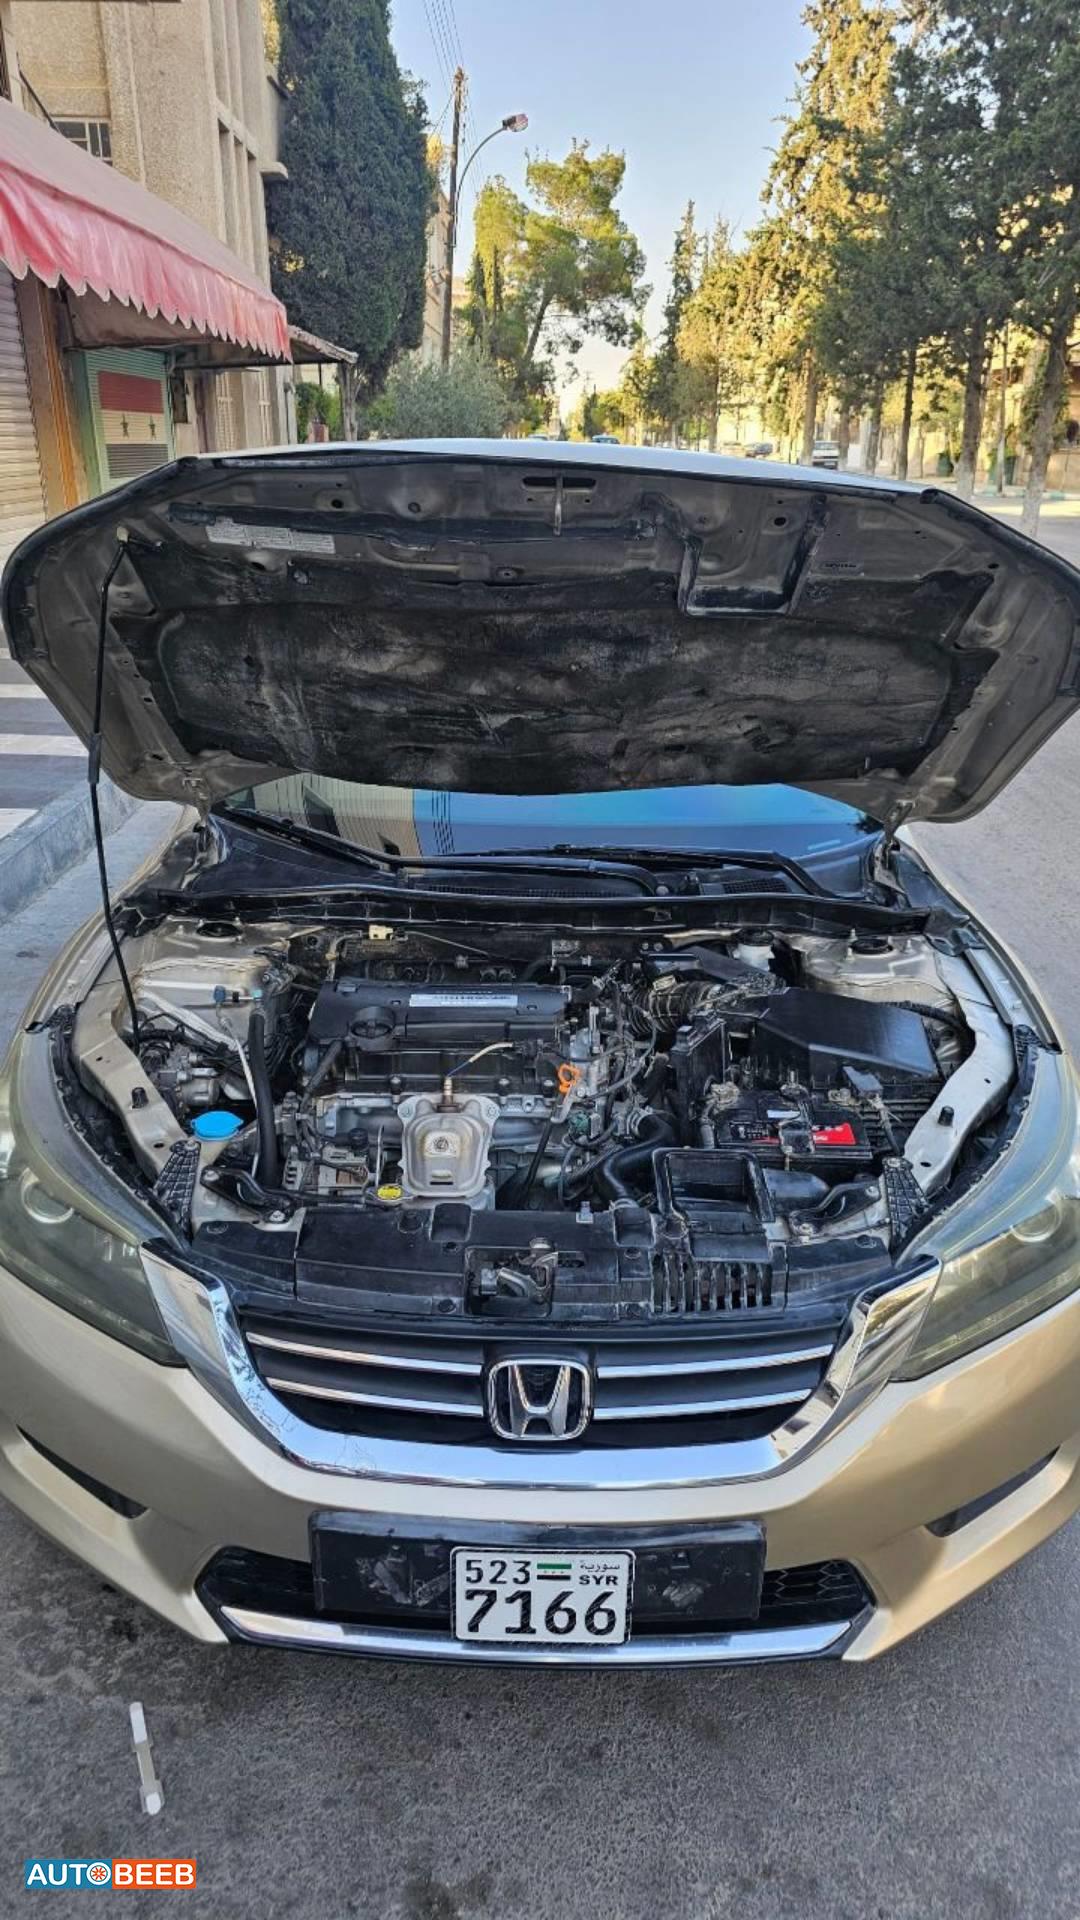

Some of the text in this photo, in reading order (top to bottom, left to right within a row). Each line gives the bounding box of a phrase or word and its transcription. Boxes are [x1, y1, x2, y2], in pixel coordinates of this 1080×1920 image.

[465, 1559, 532, 1585] 523
[579, 1560, 621, 1573] سورية
[578, 1575, 619, 1586] SYR
[464, 1589, 617, 1636] 7166
